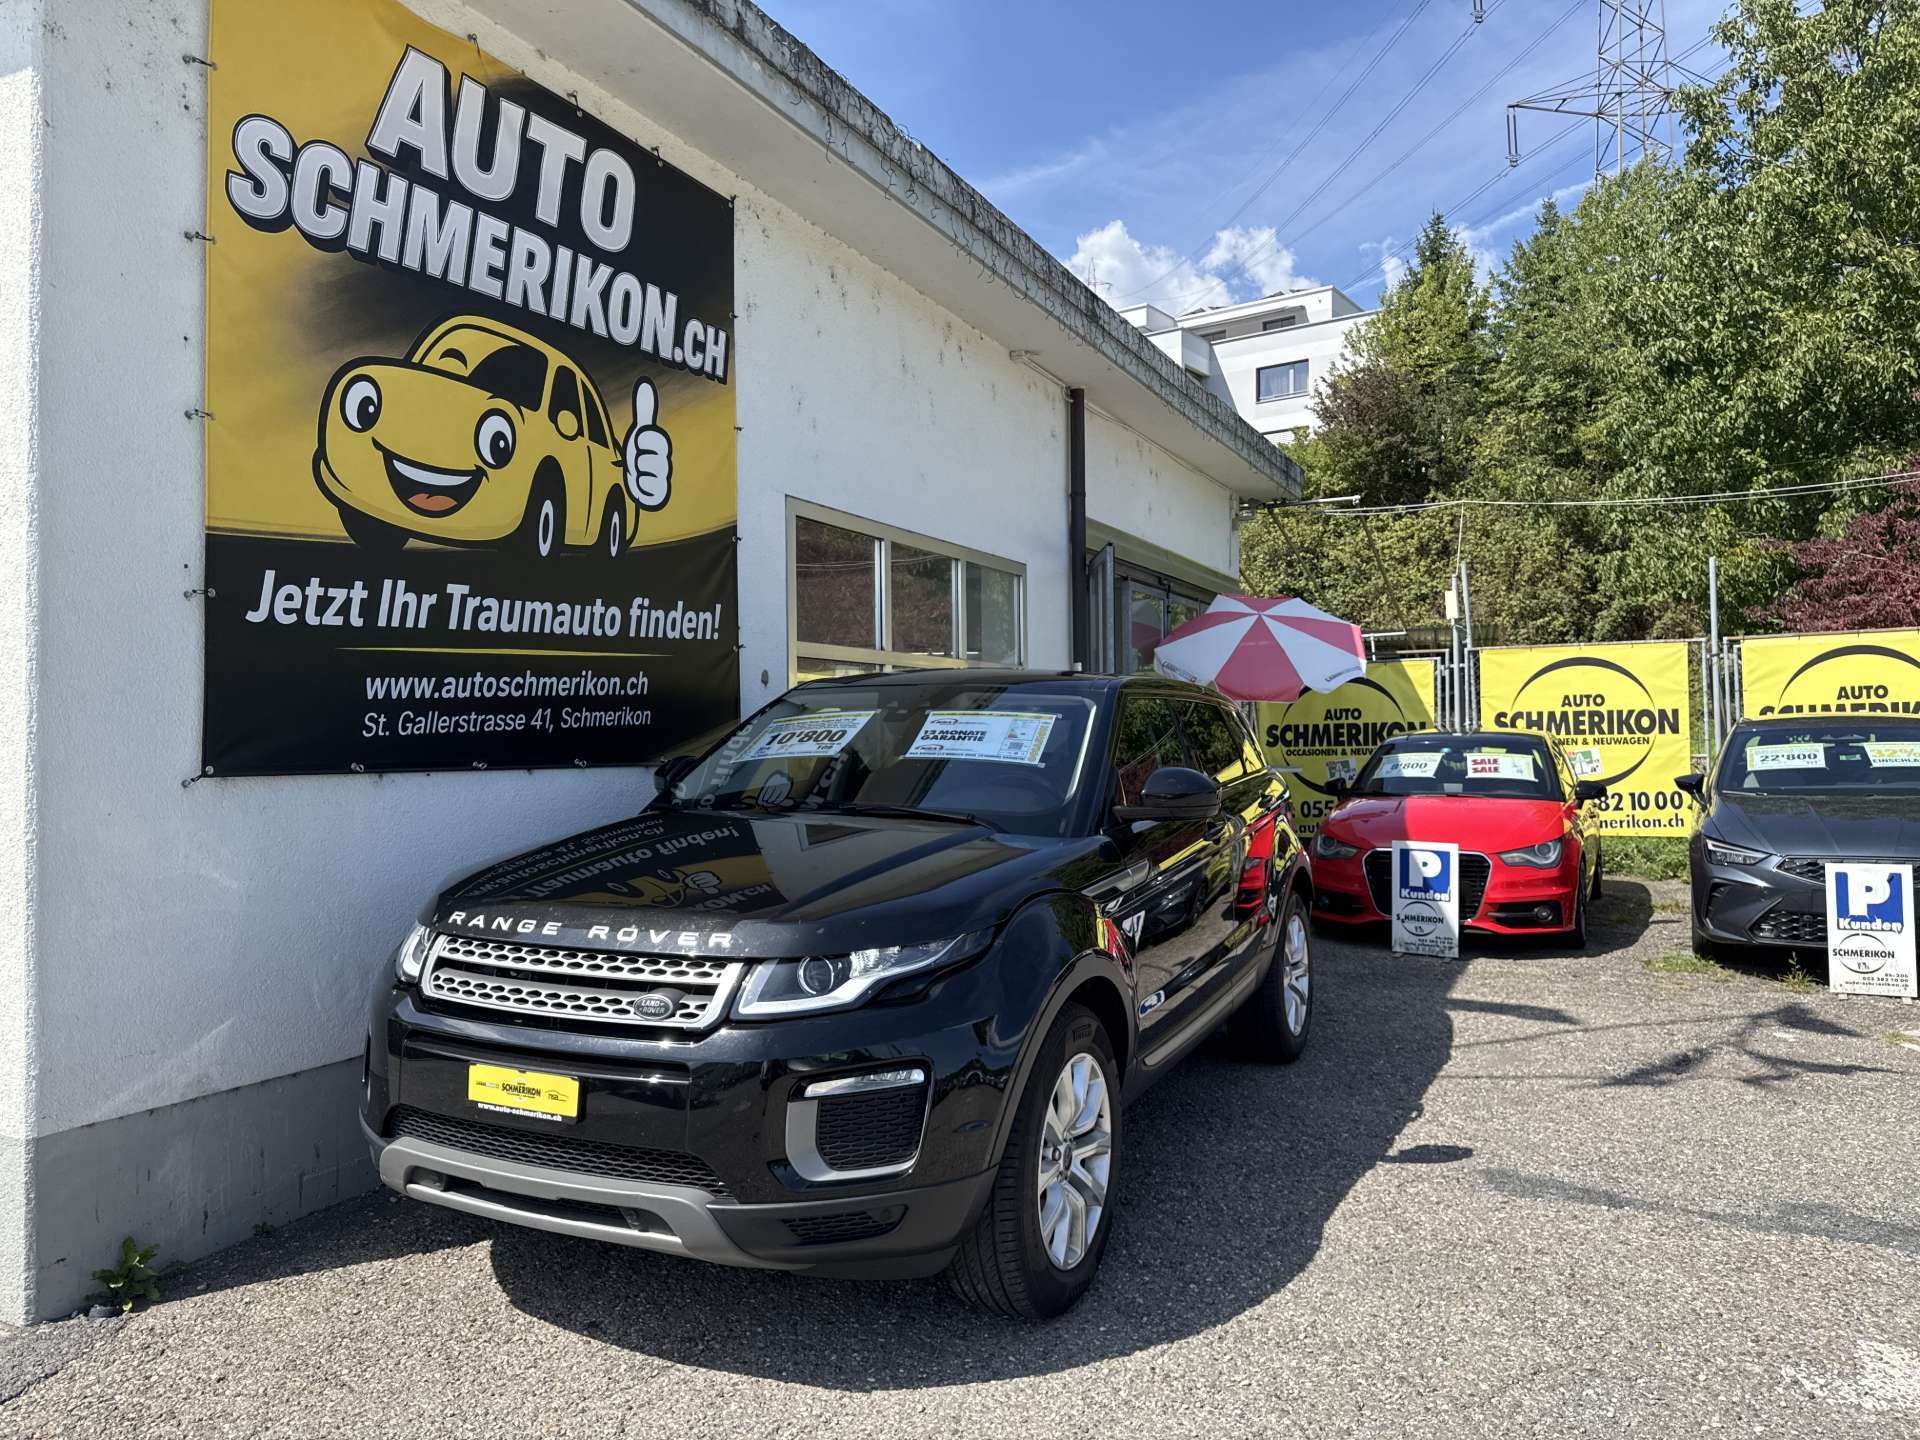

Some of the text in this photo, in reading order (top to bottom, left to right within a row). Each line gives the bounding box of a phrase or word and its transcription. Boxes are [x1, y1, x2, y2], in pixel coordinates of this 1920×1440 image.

[367, 44, 636, 253] AUTO
[226, 115, 729, 382] SCHMERIKON.CH
[246, 569, 721, 640] Jetzt Ihr Traumauto finden!
[365, 669, 649, 700] www.autoschmerikon.ch
[1837, 685, 1888, 700] AUTO
[1561, 694, 1605, 708] AUTO
[362, 707, 651, 738] St. Gallerstrasse 41, Schmerikon
[1324, 708, 1362, 721] AUTO
[1494, 708, 1680, 736] SCHMERIKON
[766, 729, 847, 746] 10'800
[1593, 736, 1650, 746] NEUWAGEN
[1286, 748, 1338, 757] OCCASIONEN
[1341, 748, 1348, 756] &
[1759, 752, 1818, 762] 22'800
[1472, 758, 1499, 766] SALE
[1472, 766, 1499, 774] SALE
[1599, 791, 1684, 811] 82 10 00
[1408, 850, 1442, 888] P
[1847, 870, 1891, 916] P
[448, 910, 734, 948] RANGE ROVER
[1839, 916, 1903, 932] Kunden
[1832, 948, 1895, 959] SCHMERIKON
[502, 1082, 541, 1097] SCHMERIKON
